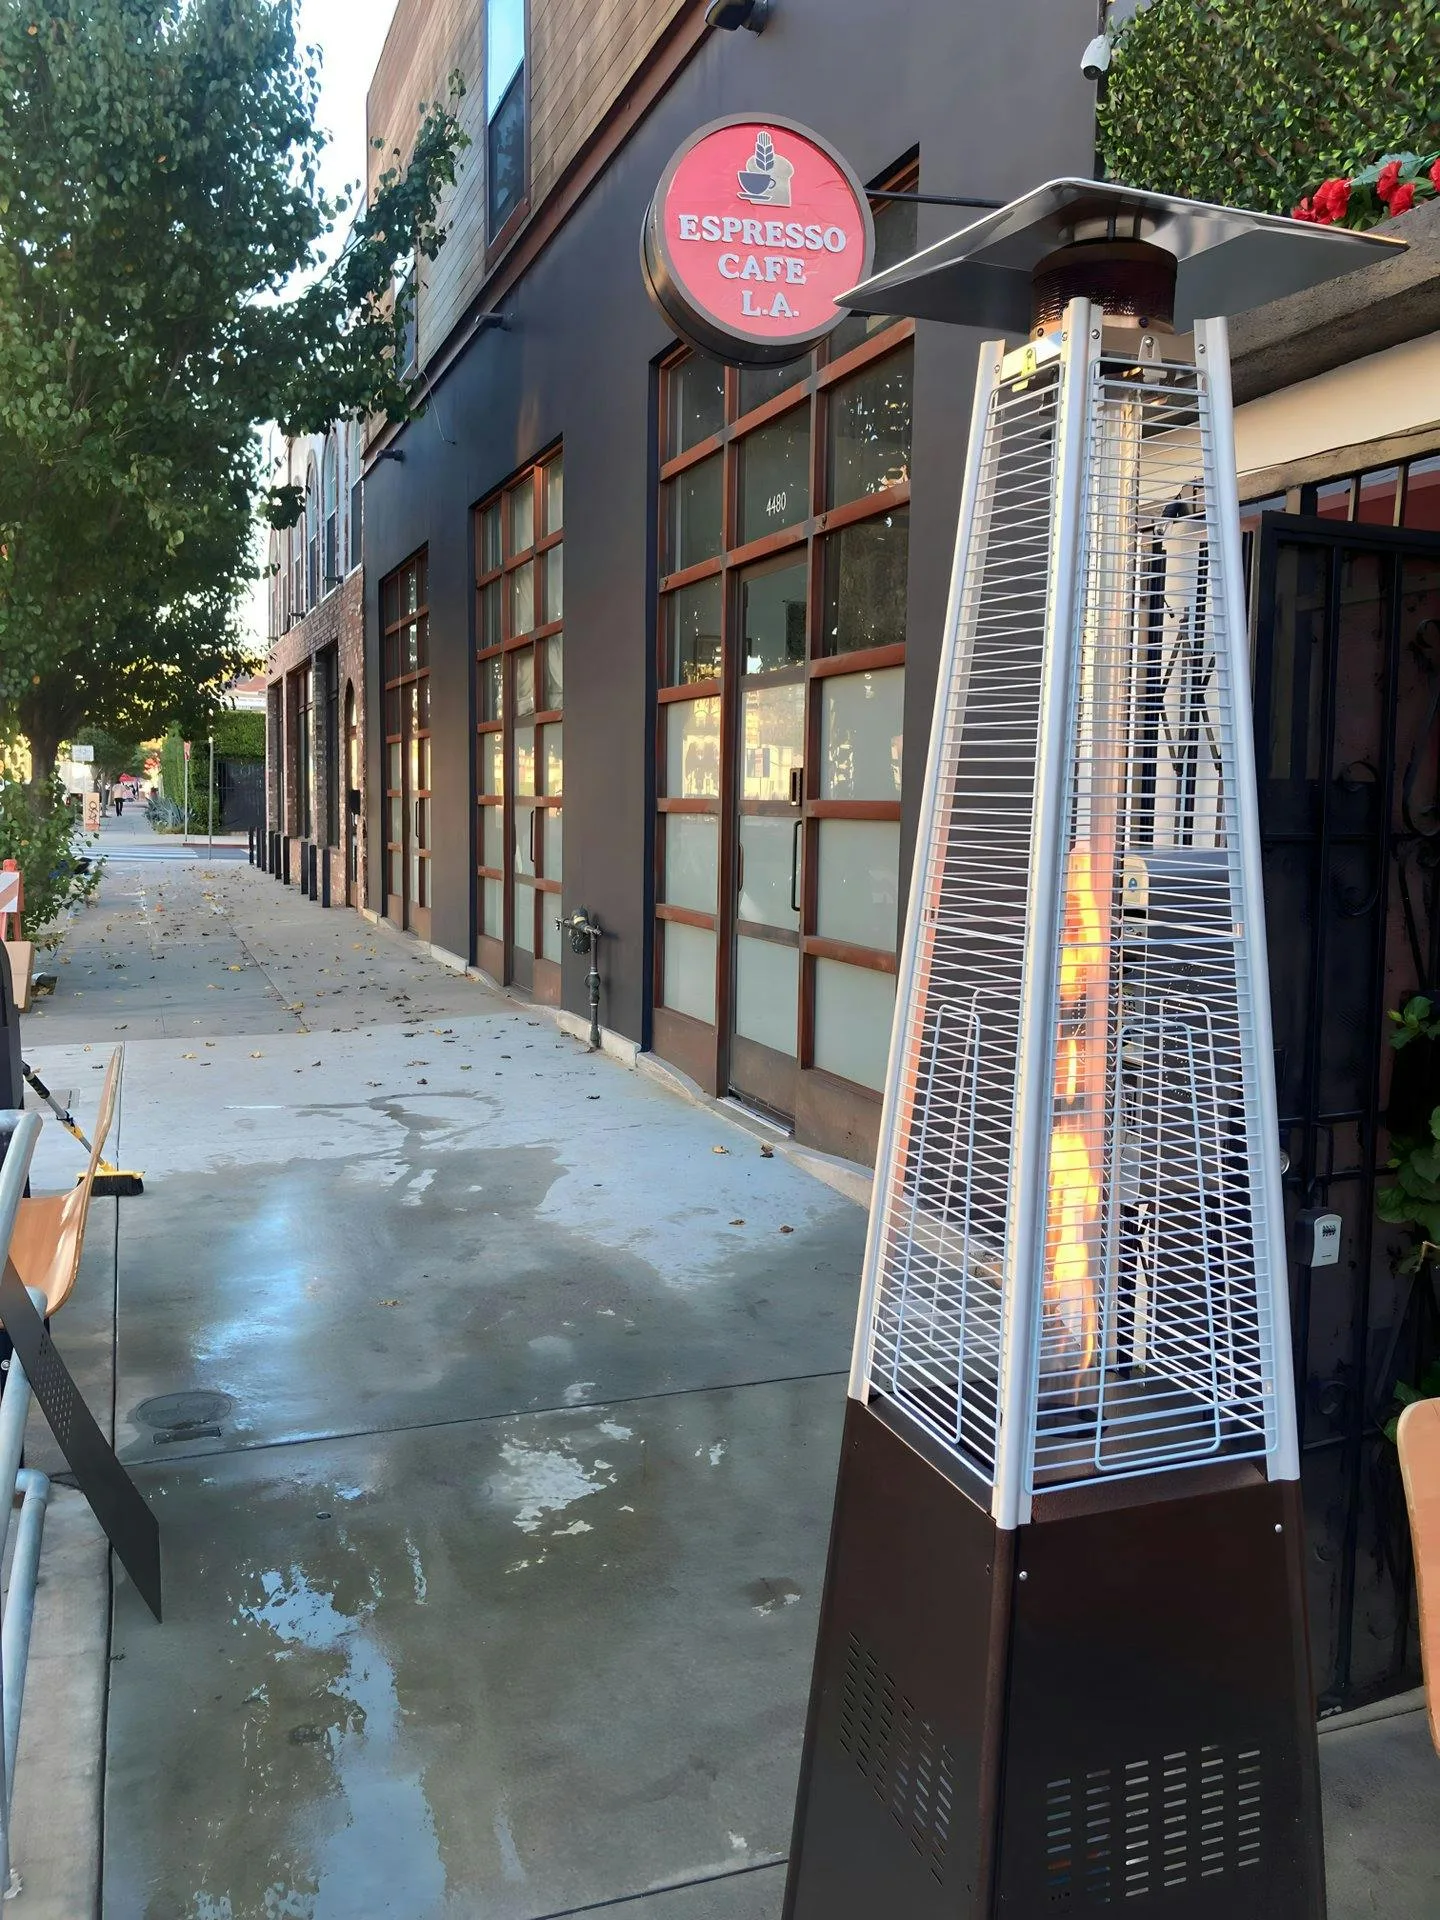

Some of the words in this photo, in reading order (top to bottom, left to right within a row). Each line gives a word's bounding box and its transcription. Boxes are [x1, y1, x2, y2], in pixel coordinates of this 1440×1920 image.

[678, 214, 847, 253] ESPRESSO
[717, 253, 806, 285] CAFE
[740, 290, 800, 318] L.A.
[765, 491, 787, 517] 4480
